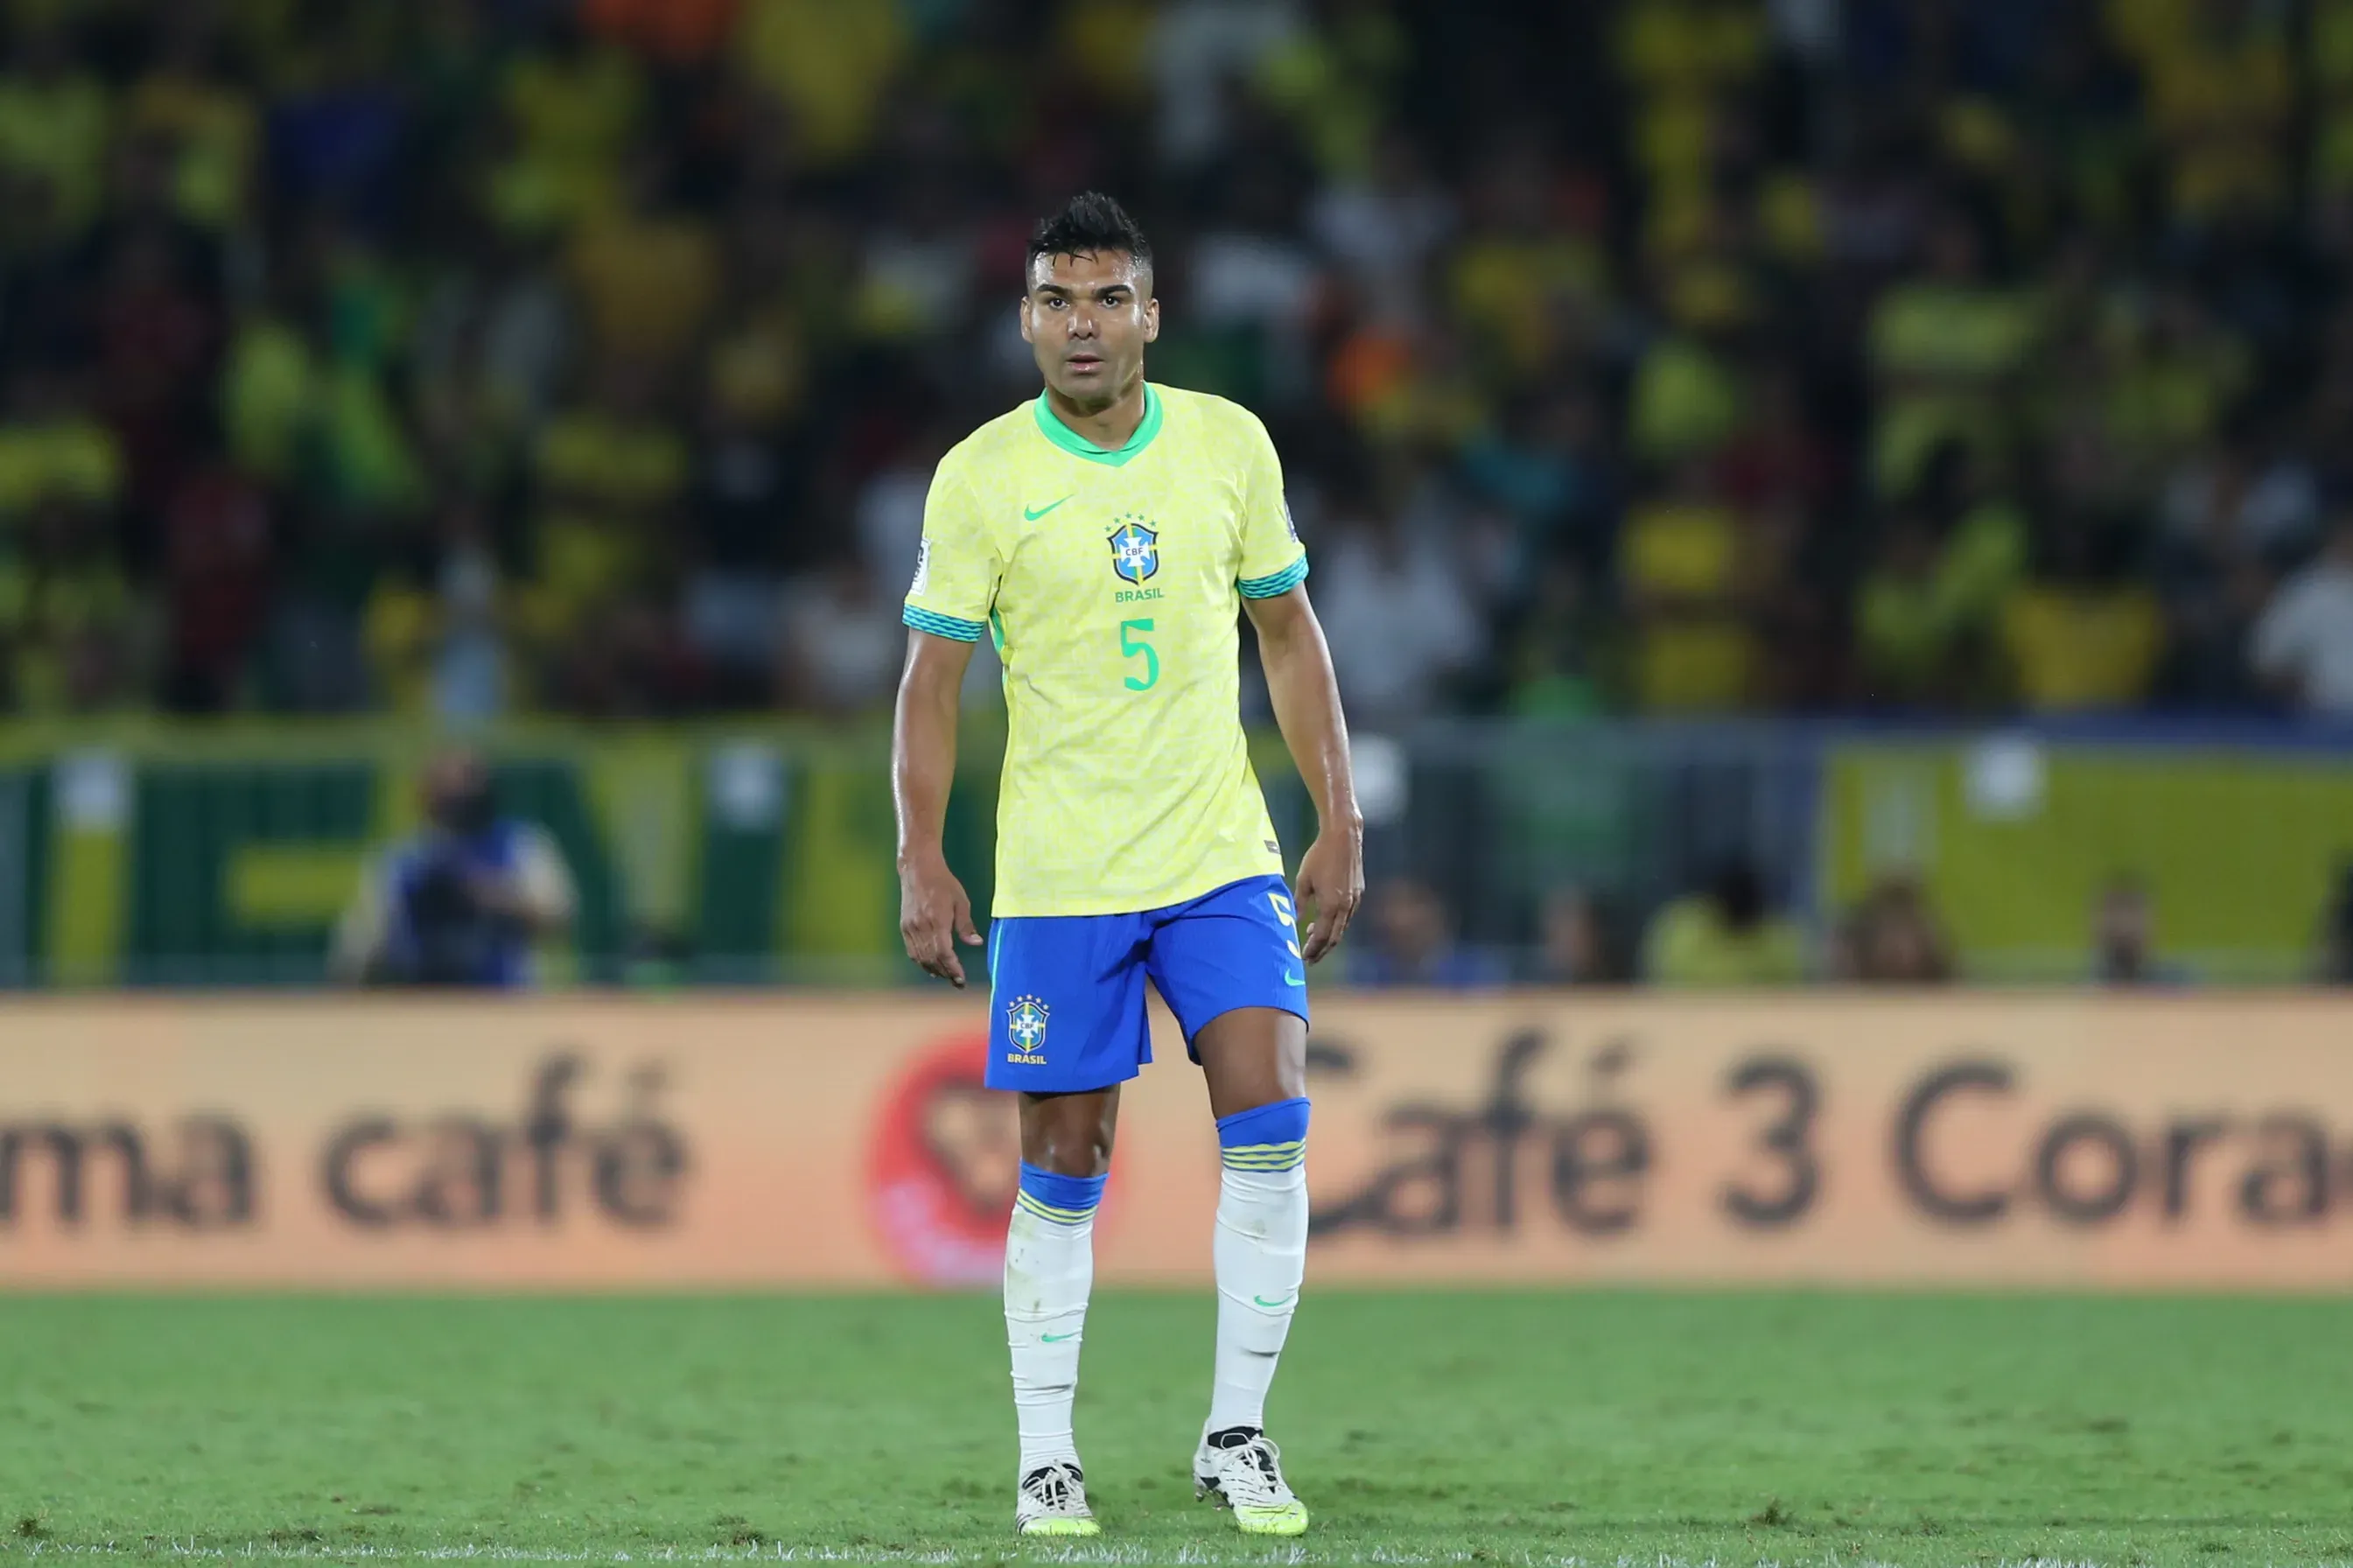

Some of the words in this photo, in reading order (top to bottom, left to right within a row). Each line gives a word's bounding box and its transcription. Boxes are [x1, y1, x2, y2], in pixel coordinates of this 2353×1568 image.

[1125, 547, 1143, 556] CBF
[1115, 588, 1165, 603] BRASIL
[1121, 618, 1159, 691] 5
[1268, 892, 1302, 960] 5
[1007, 1053, 1047, 1065] BRASIL
[320, 1047, 690, 1228] café
[1724, 1053, 1822, 1227] 3
[1888, 1053, 2353, 1228] Cora
